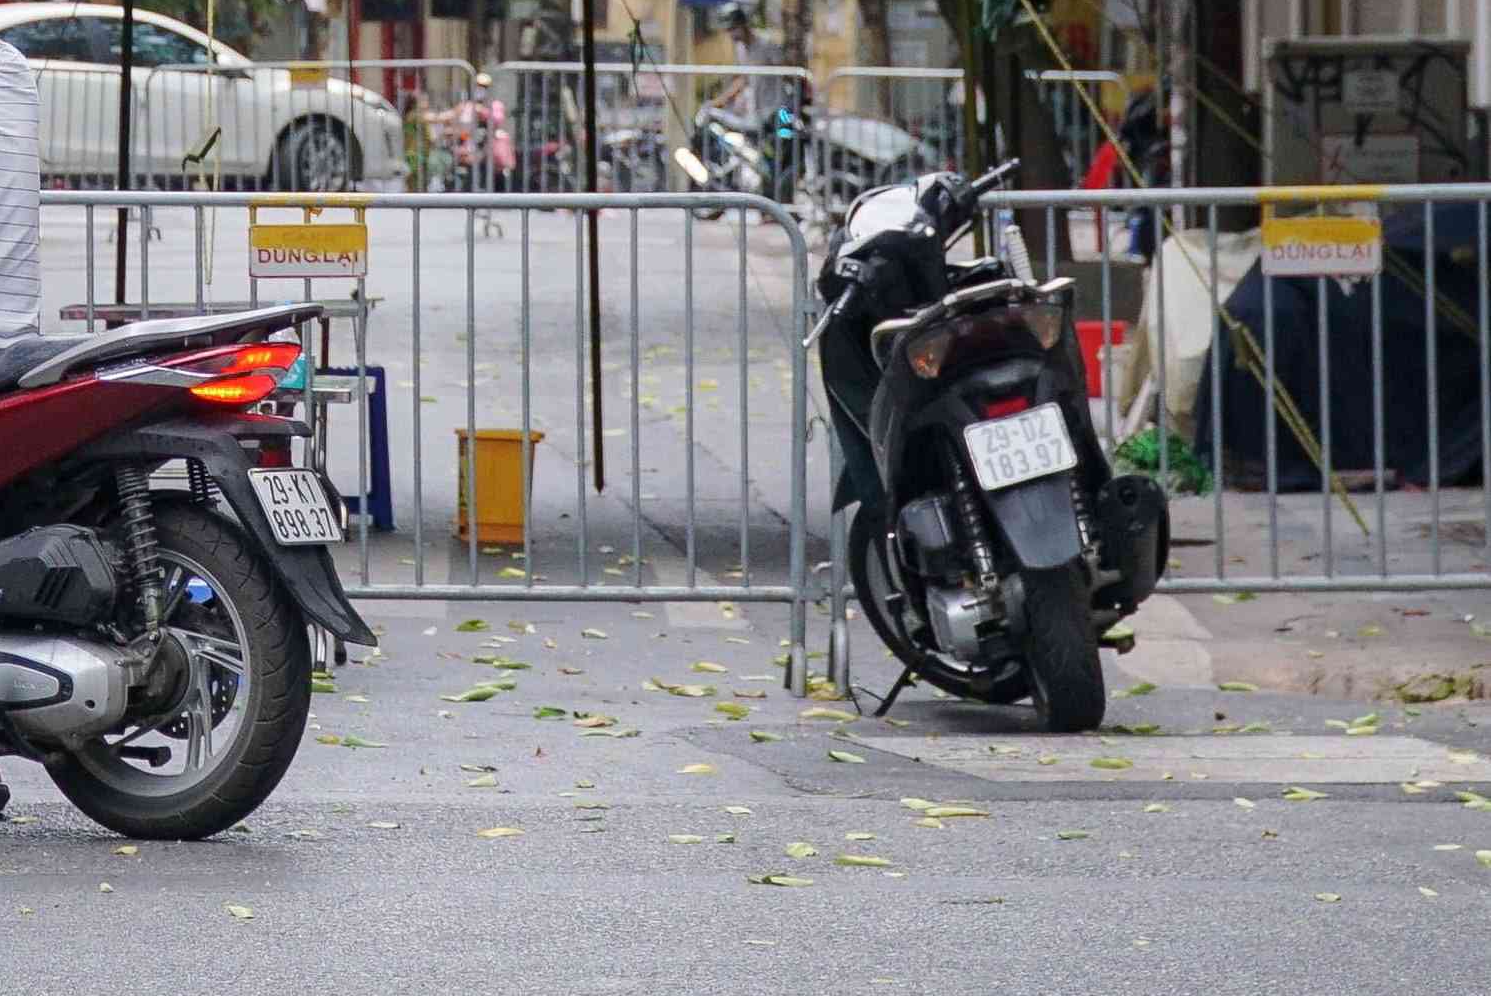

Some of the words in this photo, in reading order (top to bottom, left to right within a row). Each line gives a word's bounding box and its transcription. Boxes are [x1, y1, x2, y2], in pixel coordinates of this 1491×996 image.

[985, 438, 1063, 482] 183.97
[263, 474, 317, 505] 29-K1
[273, 507, 334, 539] 898.37
